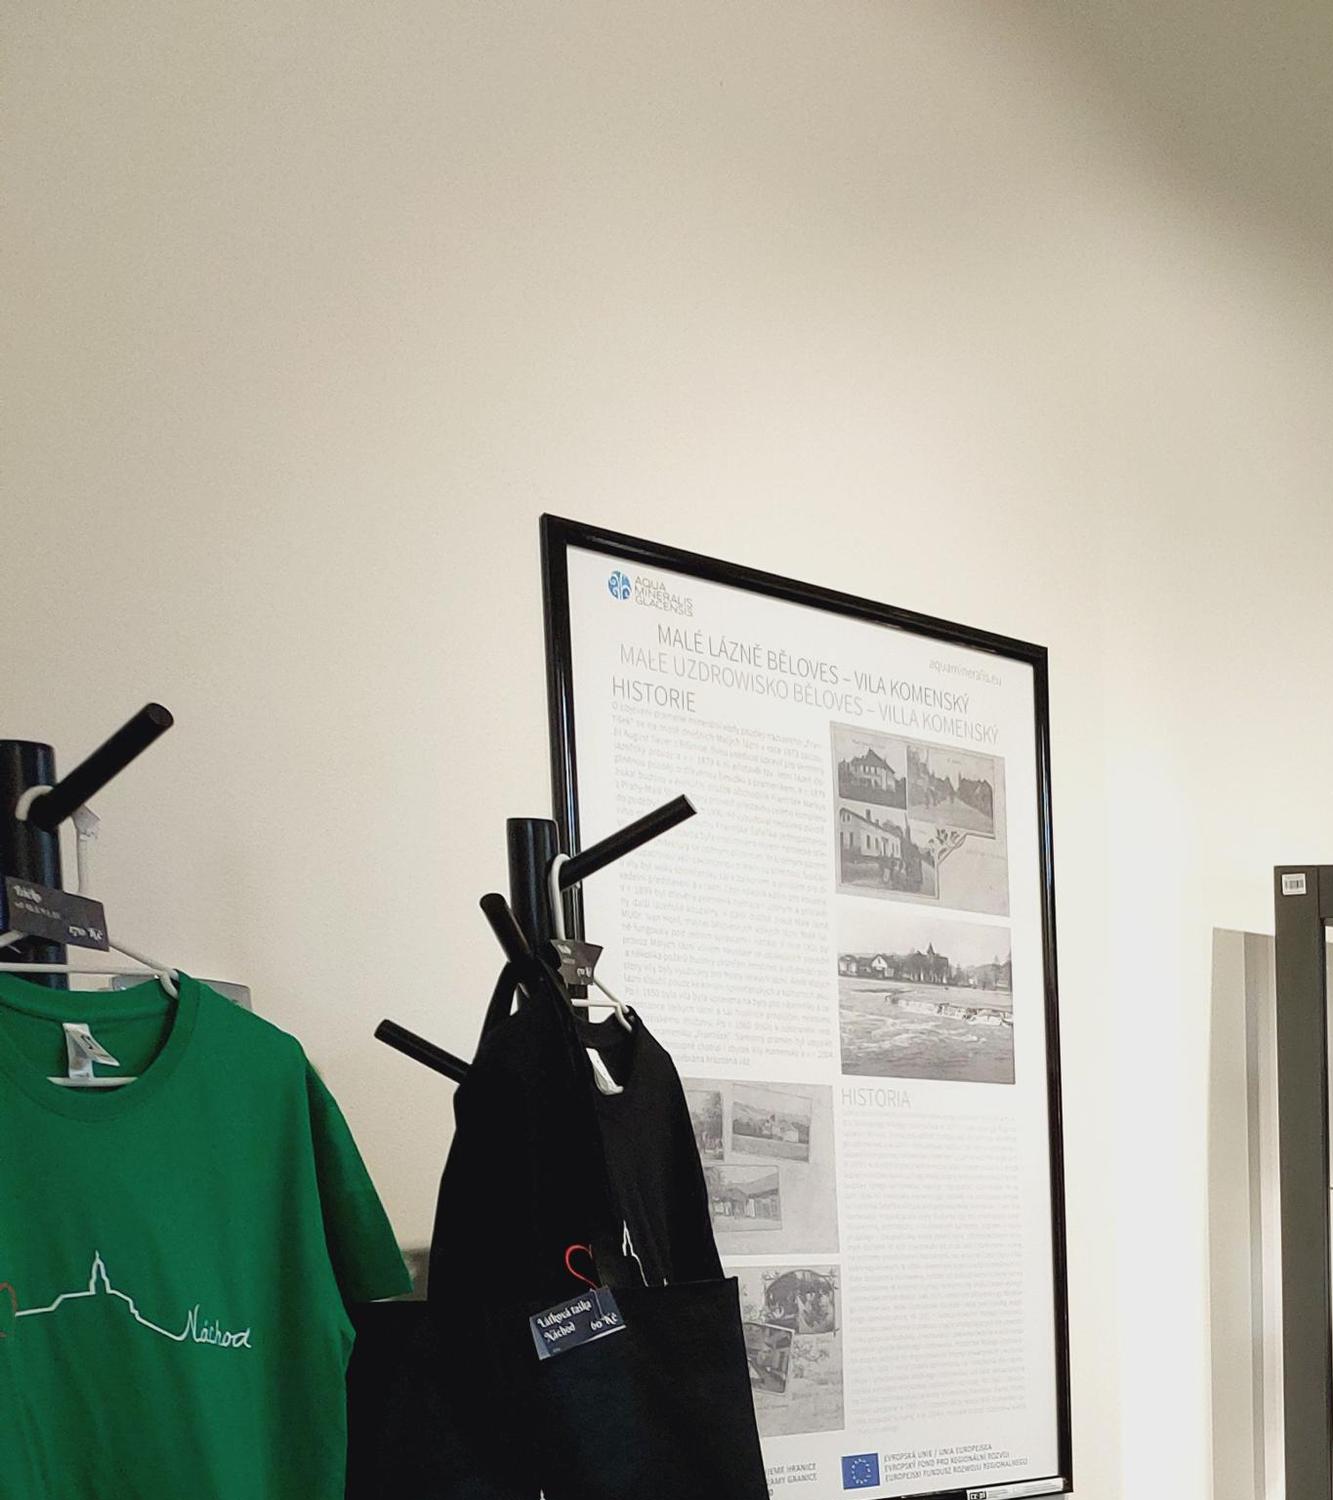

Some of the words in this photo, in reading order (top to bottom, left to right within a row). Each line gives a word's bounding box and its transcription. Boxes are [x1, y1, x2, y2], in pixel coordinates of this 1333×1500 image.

[634, 575, 667, 592] AQUA
[657, 623, 704, 655] MALÉ
[708, 635, 763, 669] LÁZNĚ
[766, 649, 839, 685] BĚLOVES
[854, 670, 887, 696] VILA
[890, 679, 971, 715] KOMENSKÝ
[611, 675, 697, 714] HISTORIE
[673, 653, 789, 700] UZDROWISKO
[793, 681, 863, 717] BĚLOVES
[878, 703, 919, 731] VILLA
[922, 712, 1000, 745] KOMENSKÝ
[841, 1087, 913, 1109] HISTORIA
[184, 1304, 252, 1349] Náchod
